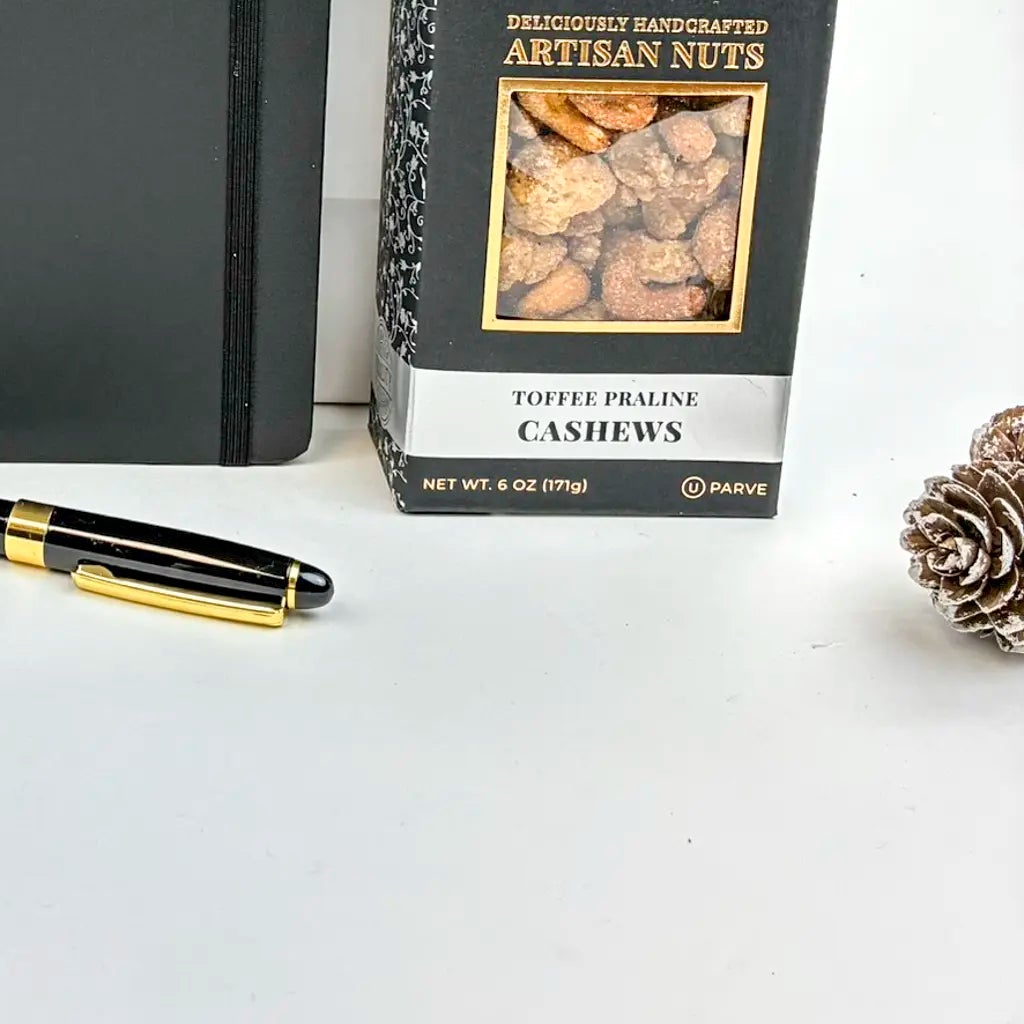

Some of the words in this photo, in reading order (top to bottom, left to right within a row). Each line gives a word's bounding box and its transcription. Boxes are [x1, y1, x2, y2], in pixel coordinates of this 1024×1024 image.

[507, 14, 628, 32] DELICIOUSLY
[633, 17, 769, 34] HANDCRAFTED
[503, 38, 663, 67] ARTISAN
[670, 41, 766, 70] NUTS
[512, 390, 598, 406] TOFFEE
[604, 391, 699, 407] PRALINE
[518, 420, 682, 443] CASHEWS
[422, 478, 457, 491] NET
[462, 478, 492, 491] WT.
[497, 479, 509, 491] 6
[512, 479, 537, 491] OZ
[542, 479, 588, 495] (171g)
[710, 483, 768, 496] PARVE
